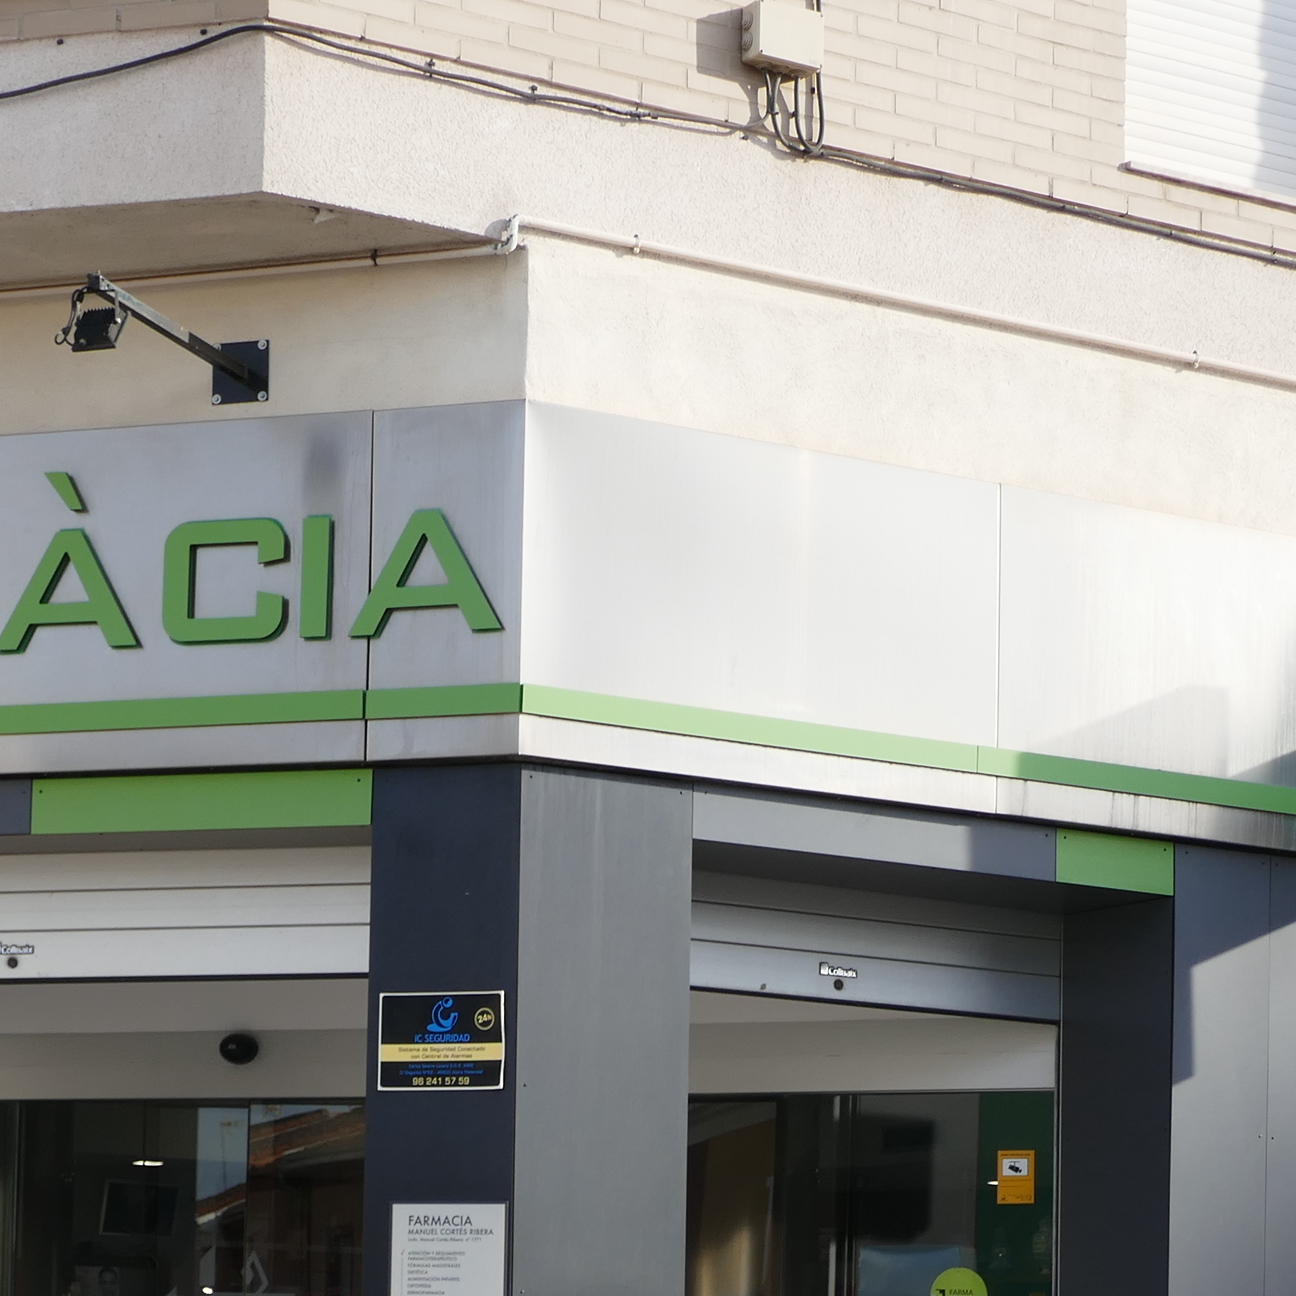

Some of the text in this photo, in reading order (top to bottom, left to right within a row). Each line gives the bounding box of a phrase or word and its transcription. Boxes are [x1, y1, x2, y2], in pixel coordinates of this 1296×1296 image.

[424, 1033, 471, 1042] SEGURIDAD
[412, 1076, 470, 1086] 96 241 57 59
[408, 1215, 473, 1226] FARMACIA
